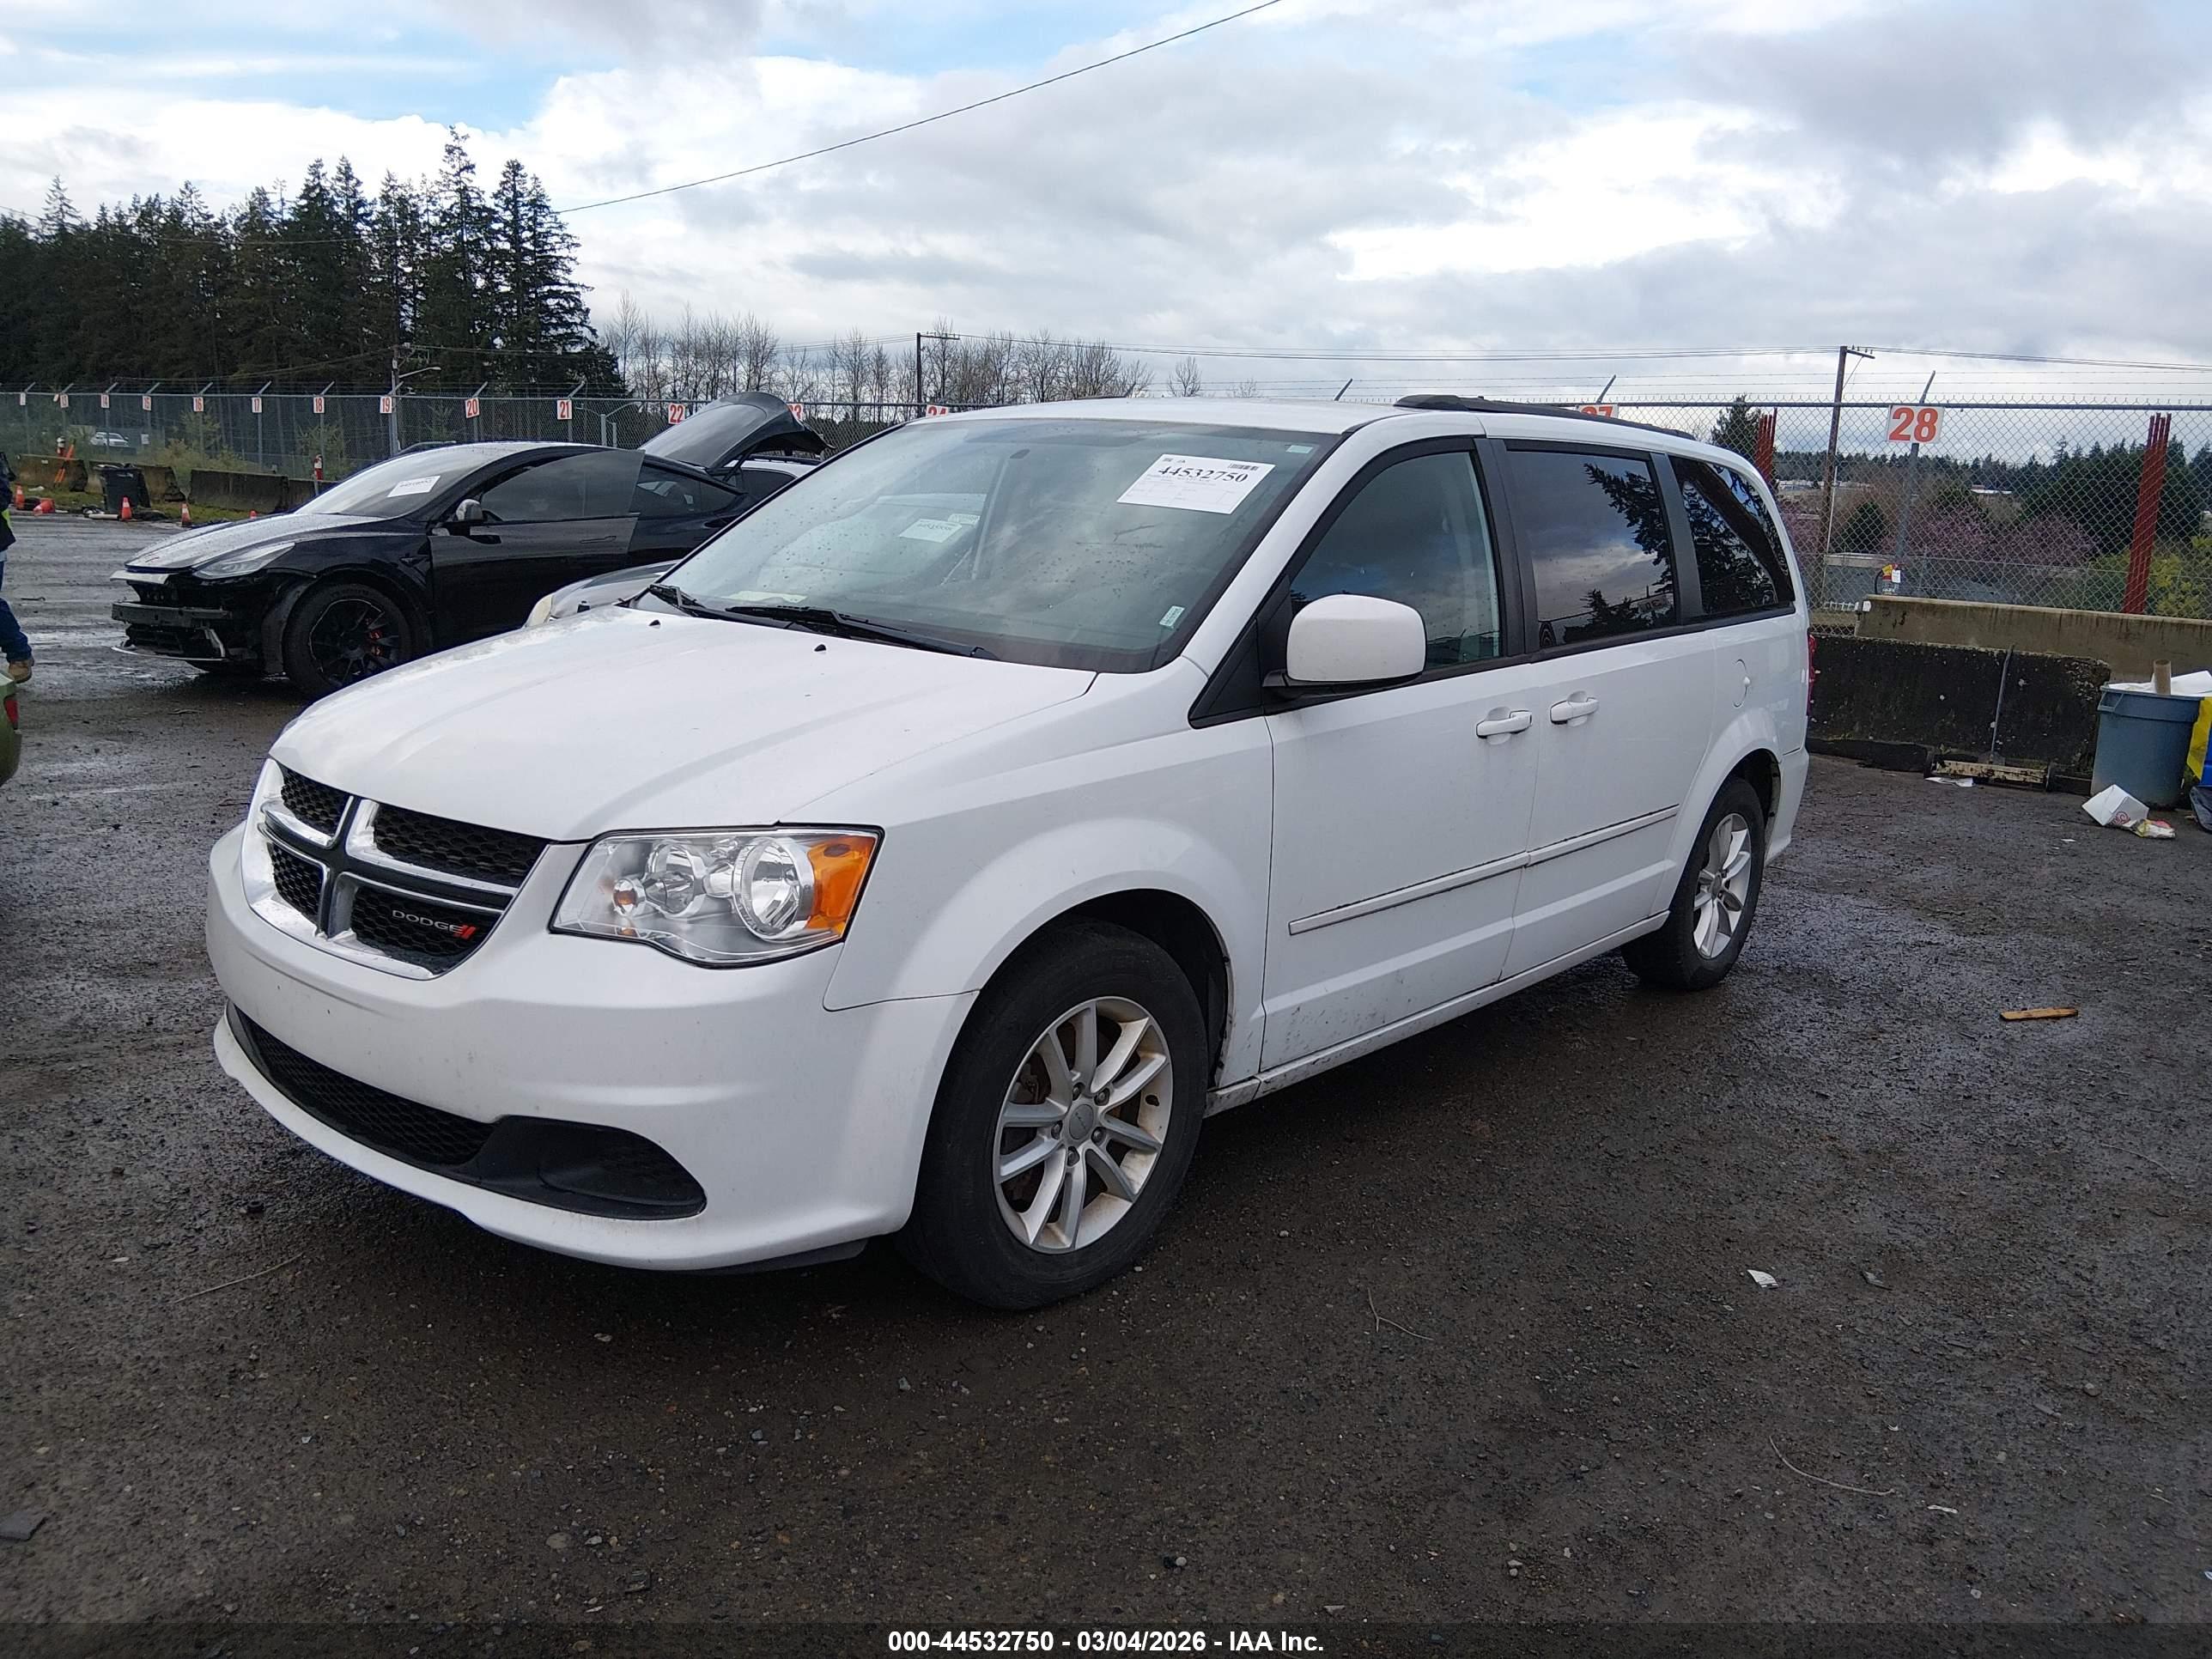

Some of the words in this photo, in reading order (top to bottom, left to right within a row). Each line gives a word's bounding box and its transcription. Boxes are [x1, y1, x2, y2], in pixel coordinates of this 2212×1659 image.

[195, 398, 203, 410] 16
[315, 398, 323, 412] 18
[382, 398, 390, 412] 19
[467, 399, 477, 416] 20
[560, 401, 569, 418] 21
[670, 404, 684, 422] 22
[1889, 407, 1938, 442] 28
[1158, 466, 1249, 483] 44532750
[392, 910, 464, 934] DODGE
